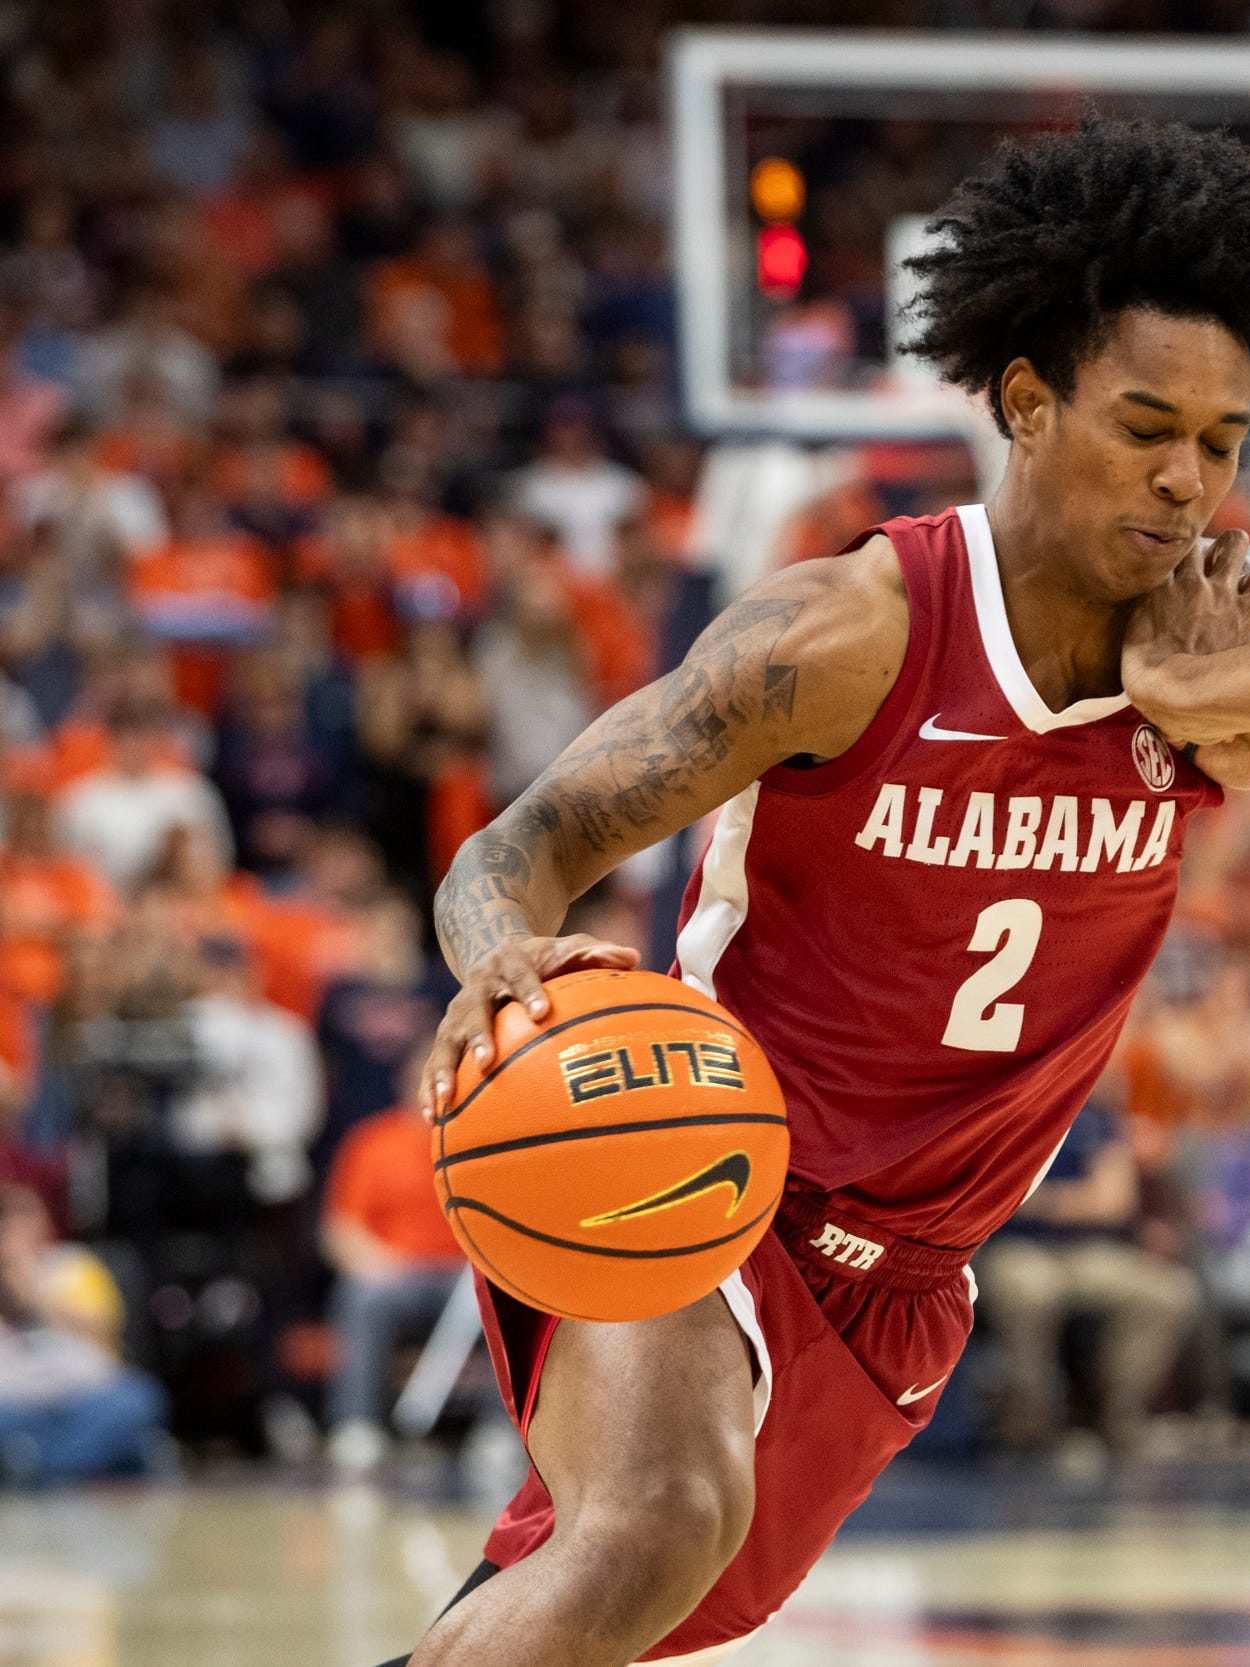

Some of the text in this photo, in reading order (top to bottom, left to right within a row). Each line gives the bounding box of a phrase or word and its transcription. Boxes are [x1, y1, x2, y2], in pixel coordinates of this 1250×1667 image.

[1135, 727, 1173, 788] SEC
[854, 783, 1177, 874] ALABAMA
[940, 898, 1043, 1052] 2
[560, 1041, 747, 1107] ELITE
[809, 1223, 885, 1271] RTR
